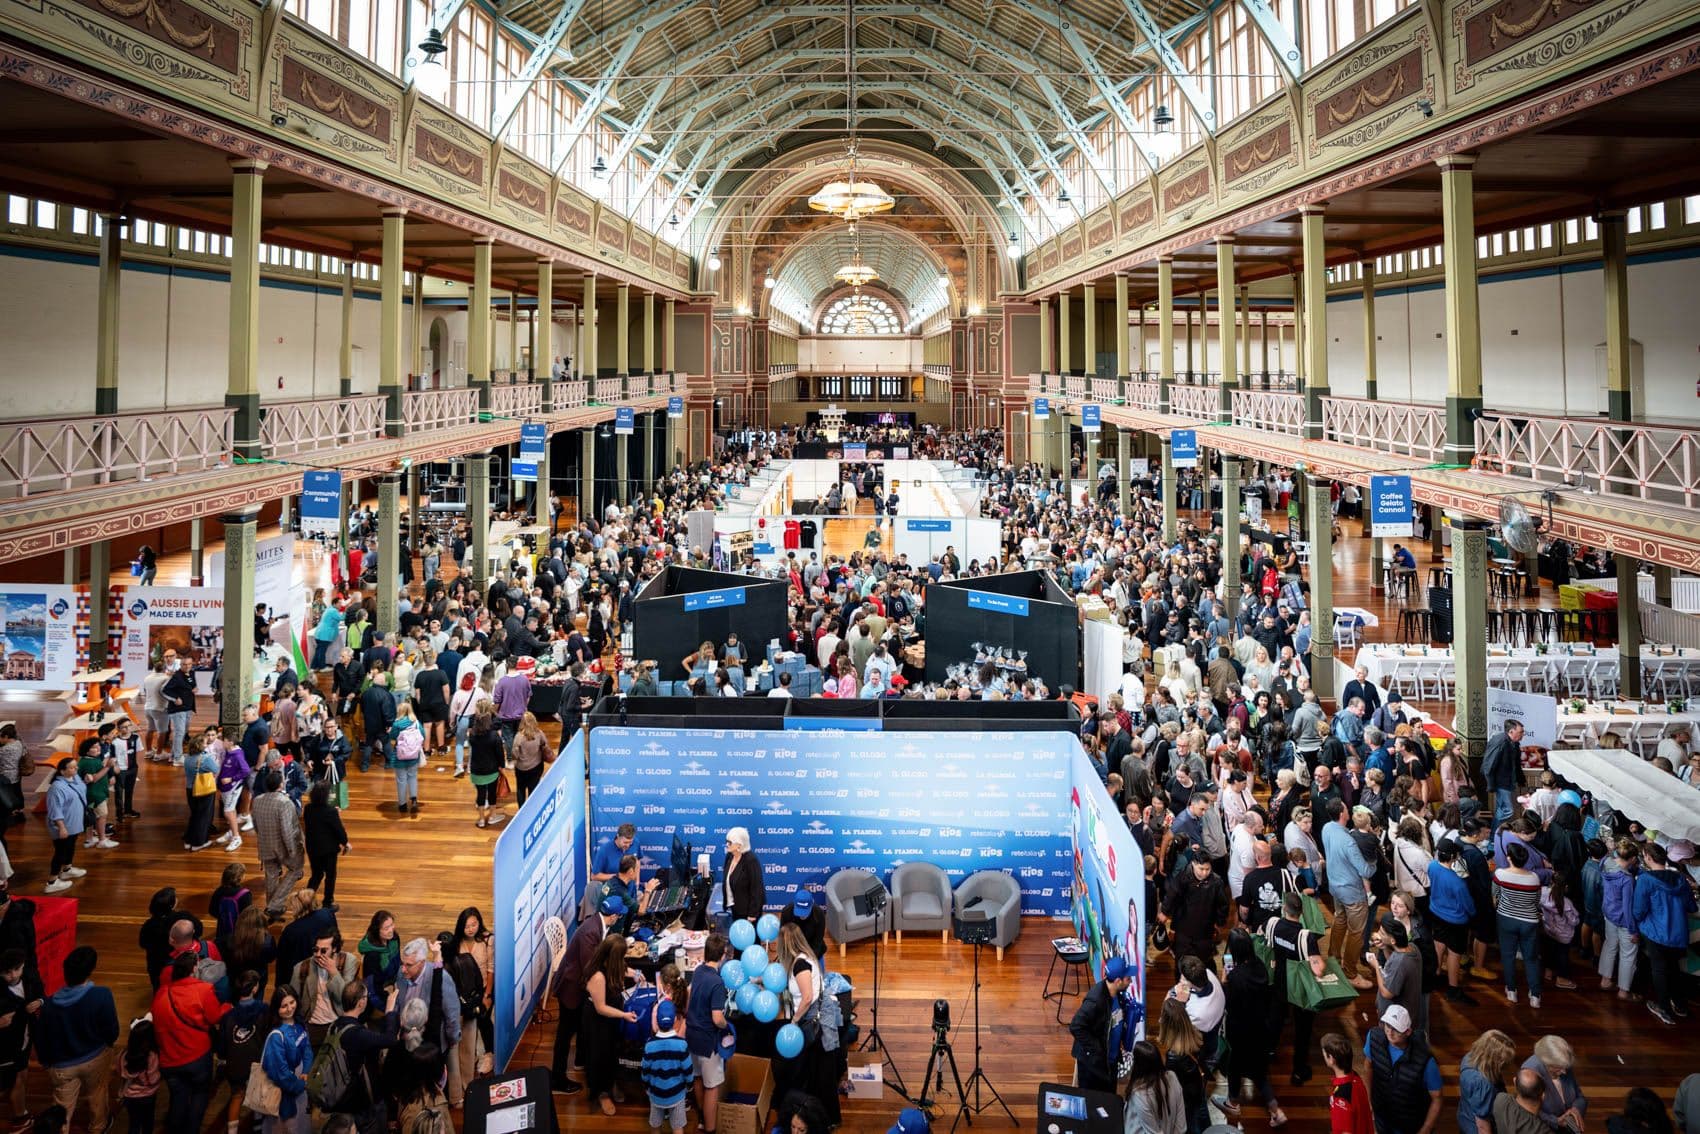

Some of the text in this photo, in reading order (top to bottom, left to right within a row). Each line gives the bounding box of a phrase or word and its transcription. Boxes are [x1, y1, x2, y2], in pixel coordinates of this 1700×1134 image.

[304, 490, 339, 498] Community
[150, 599, 190, 608] AUSSIE
[1492, 706, 1524, 716] puopolo
[533, 798, 554, 838] GLOBO
